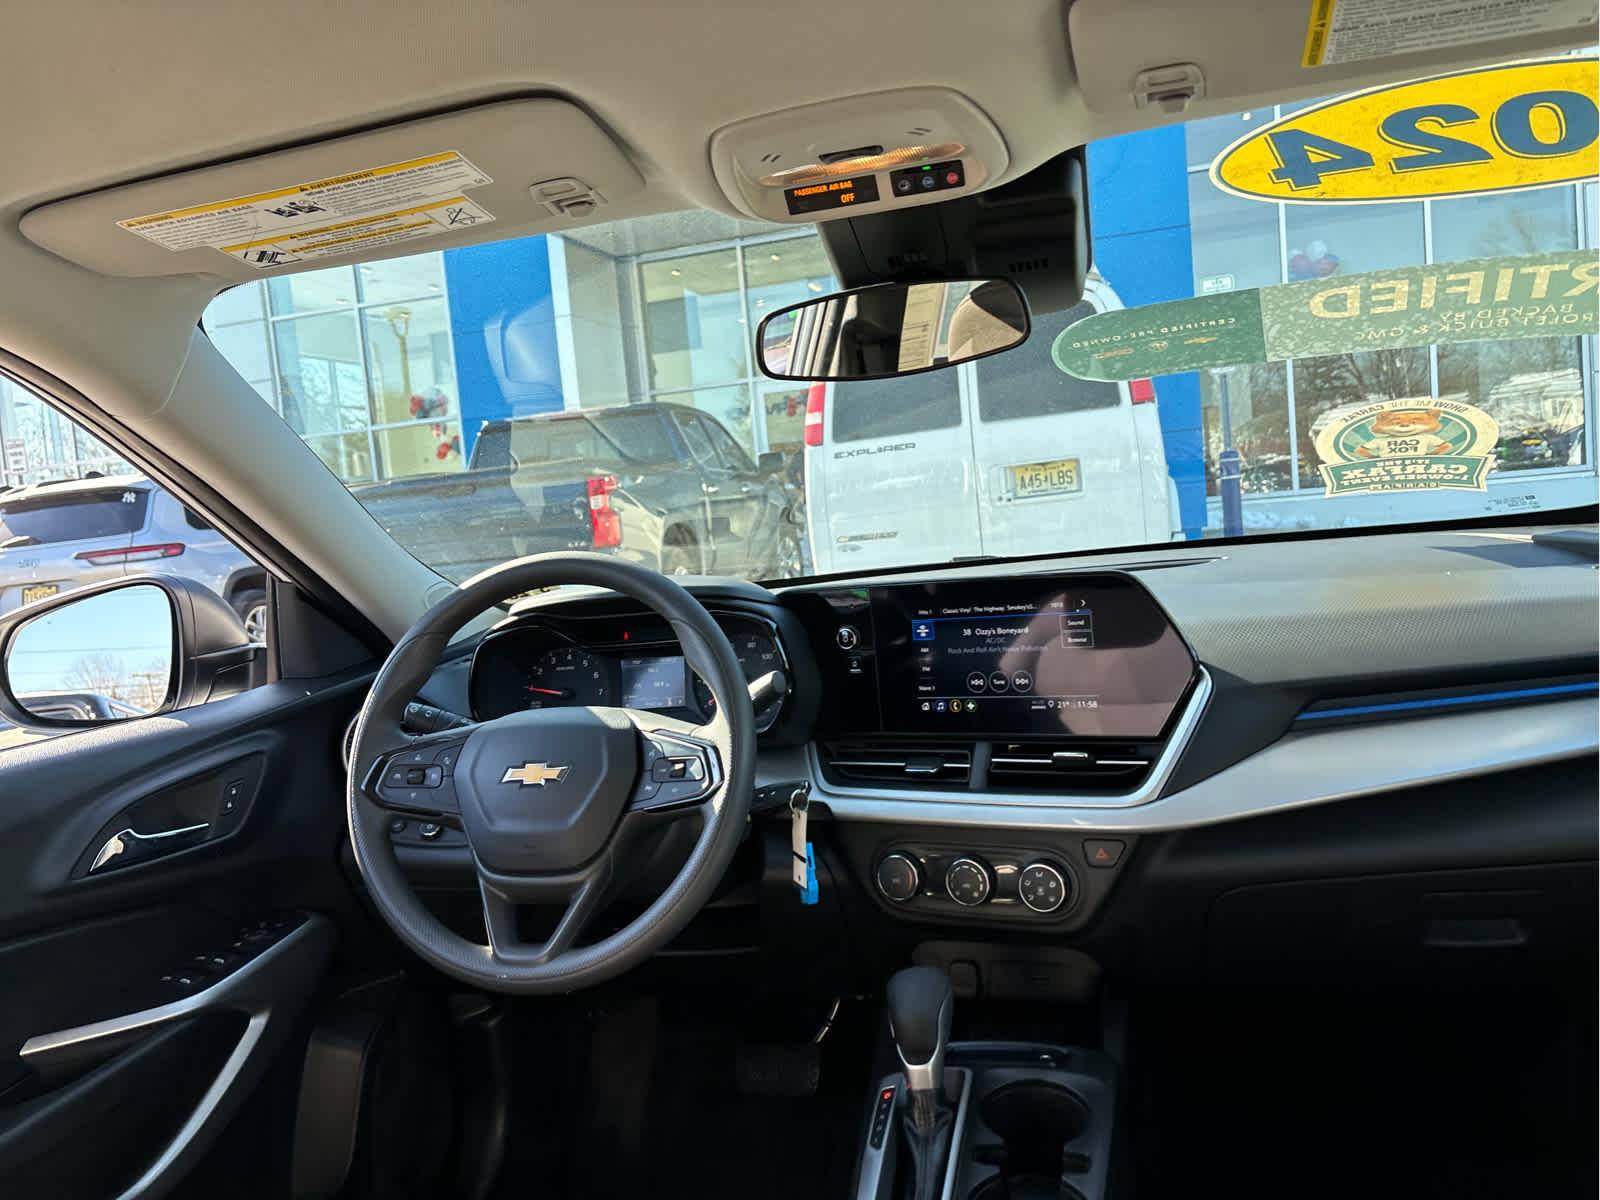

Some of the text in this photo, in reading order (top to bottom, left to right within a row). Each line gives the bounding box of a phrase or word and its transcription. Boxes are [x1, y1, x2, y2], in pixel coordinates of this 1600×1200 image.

[794, 183, 829, 197] PASSENGER
[840, 193, 855, 204] OFF
[962, 628, 972, 636] 38
[997, 626, 1029, 636] Boneyard
